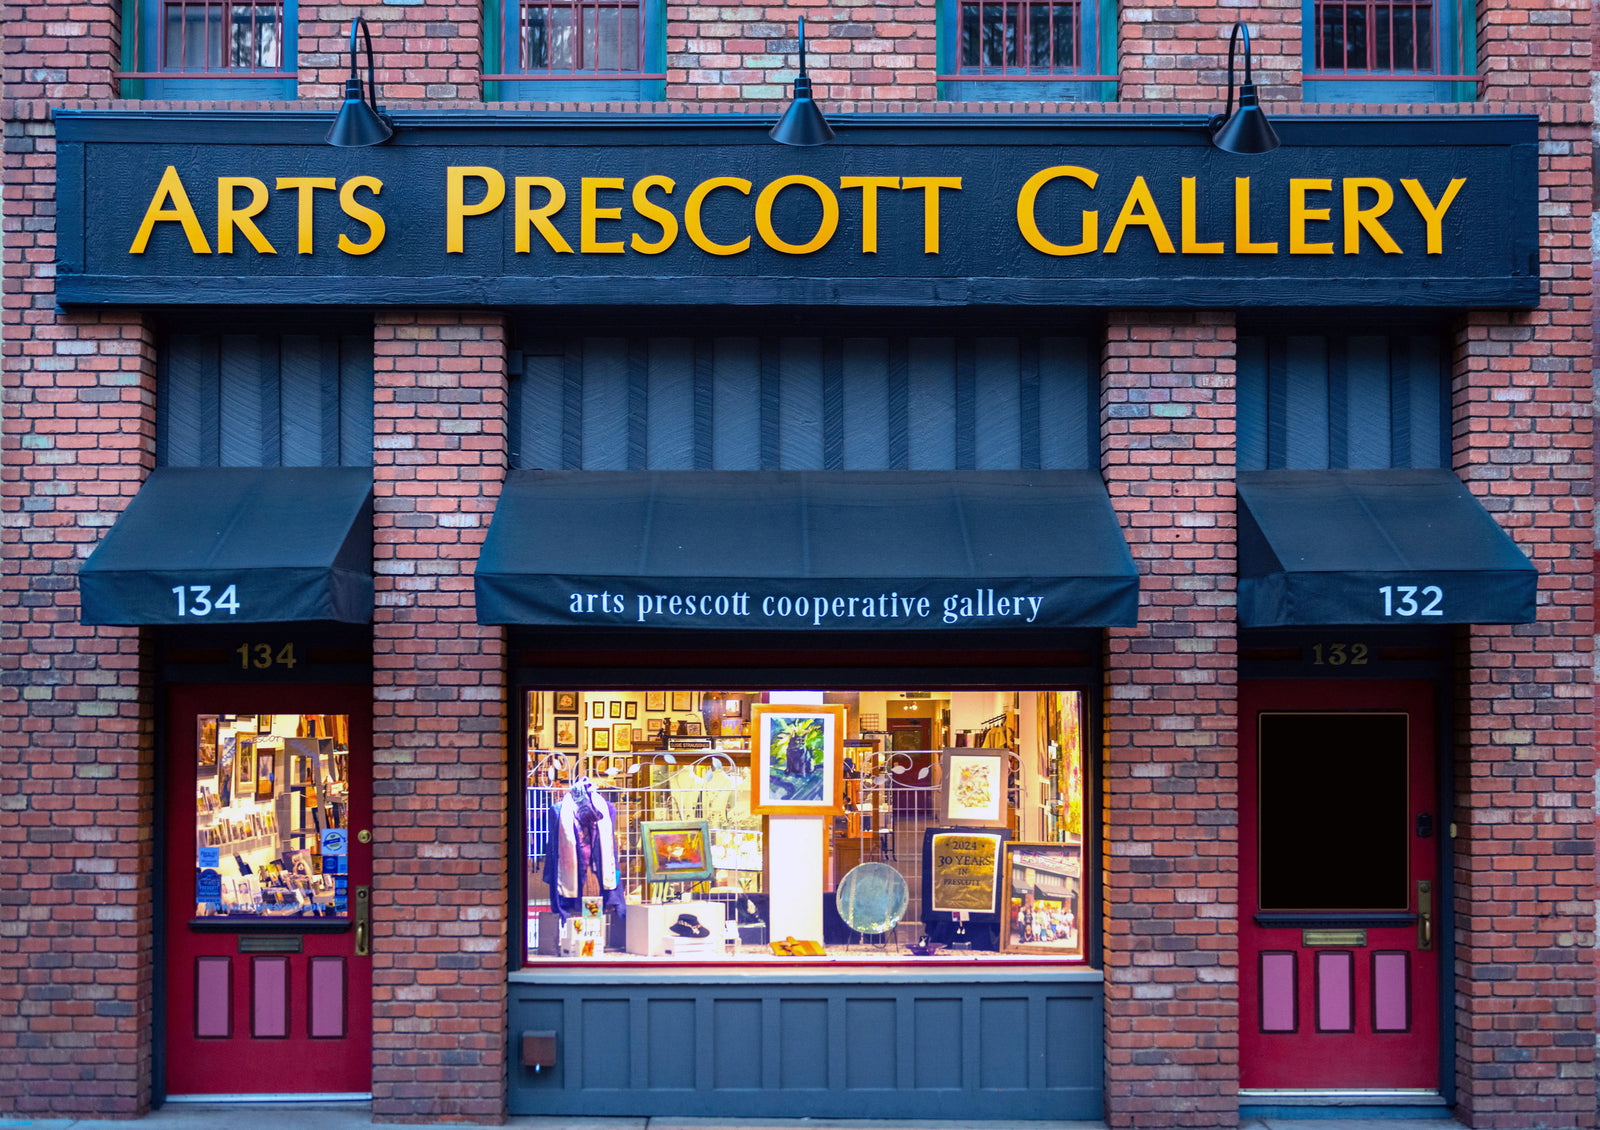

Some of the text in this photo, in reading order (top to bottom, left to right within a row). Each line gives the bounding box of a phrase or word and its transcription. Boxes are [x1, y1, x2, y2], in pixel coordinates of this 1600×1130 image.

[129, 164, 1468, 257] ARTS PRESCOTT GALLERY
[172, 585, 240, 616] 134
[568, 588, 1044, 627] arts prescott cooperative gallery
[1378, 585, 1444, 618] 132
[236, 643, 298, 670] 134
[1312, 643, 1369, 666] 132
[953, 841, 977, 850] 2024
[938, 855, 992, 867] 30 YEARS
[943, 878, 980, 886] PRESCOTT
